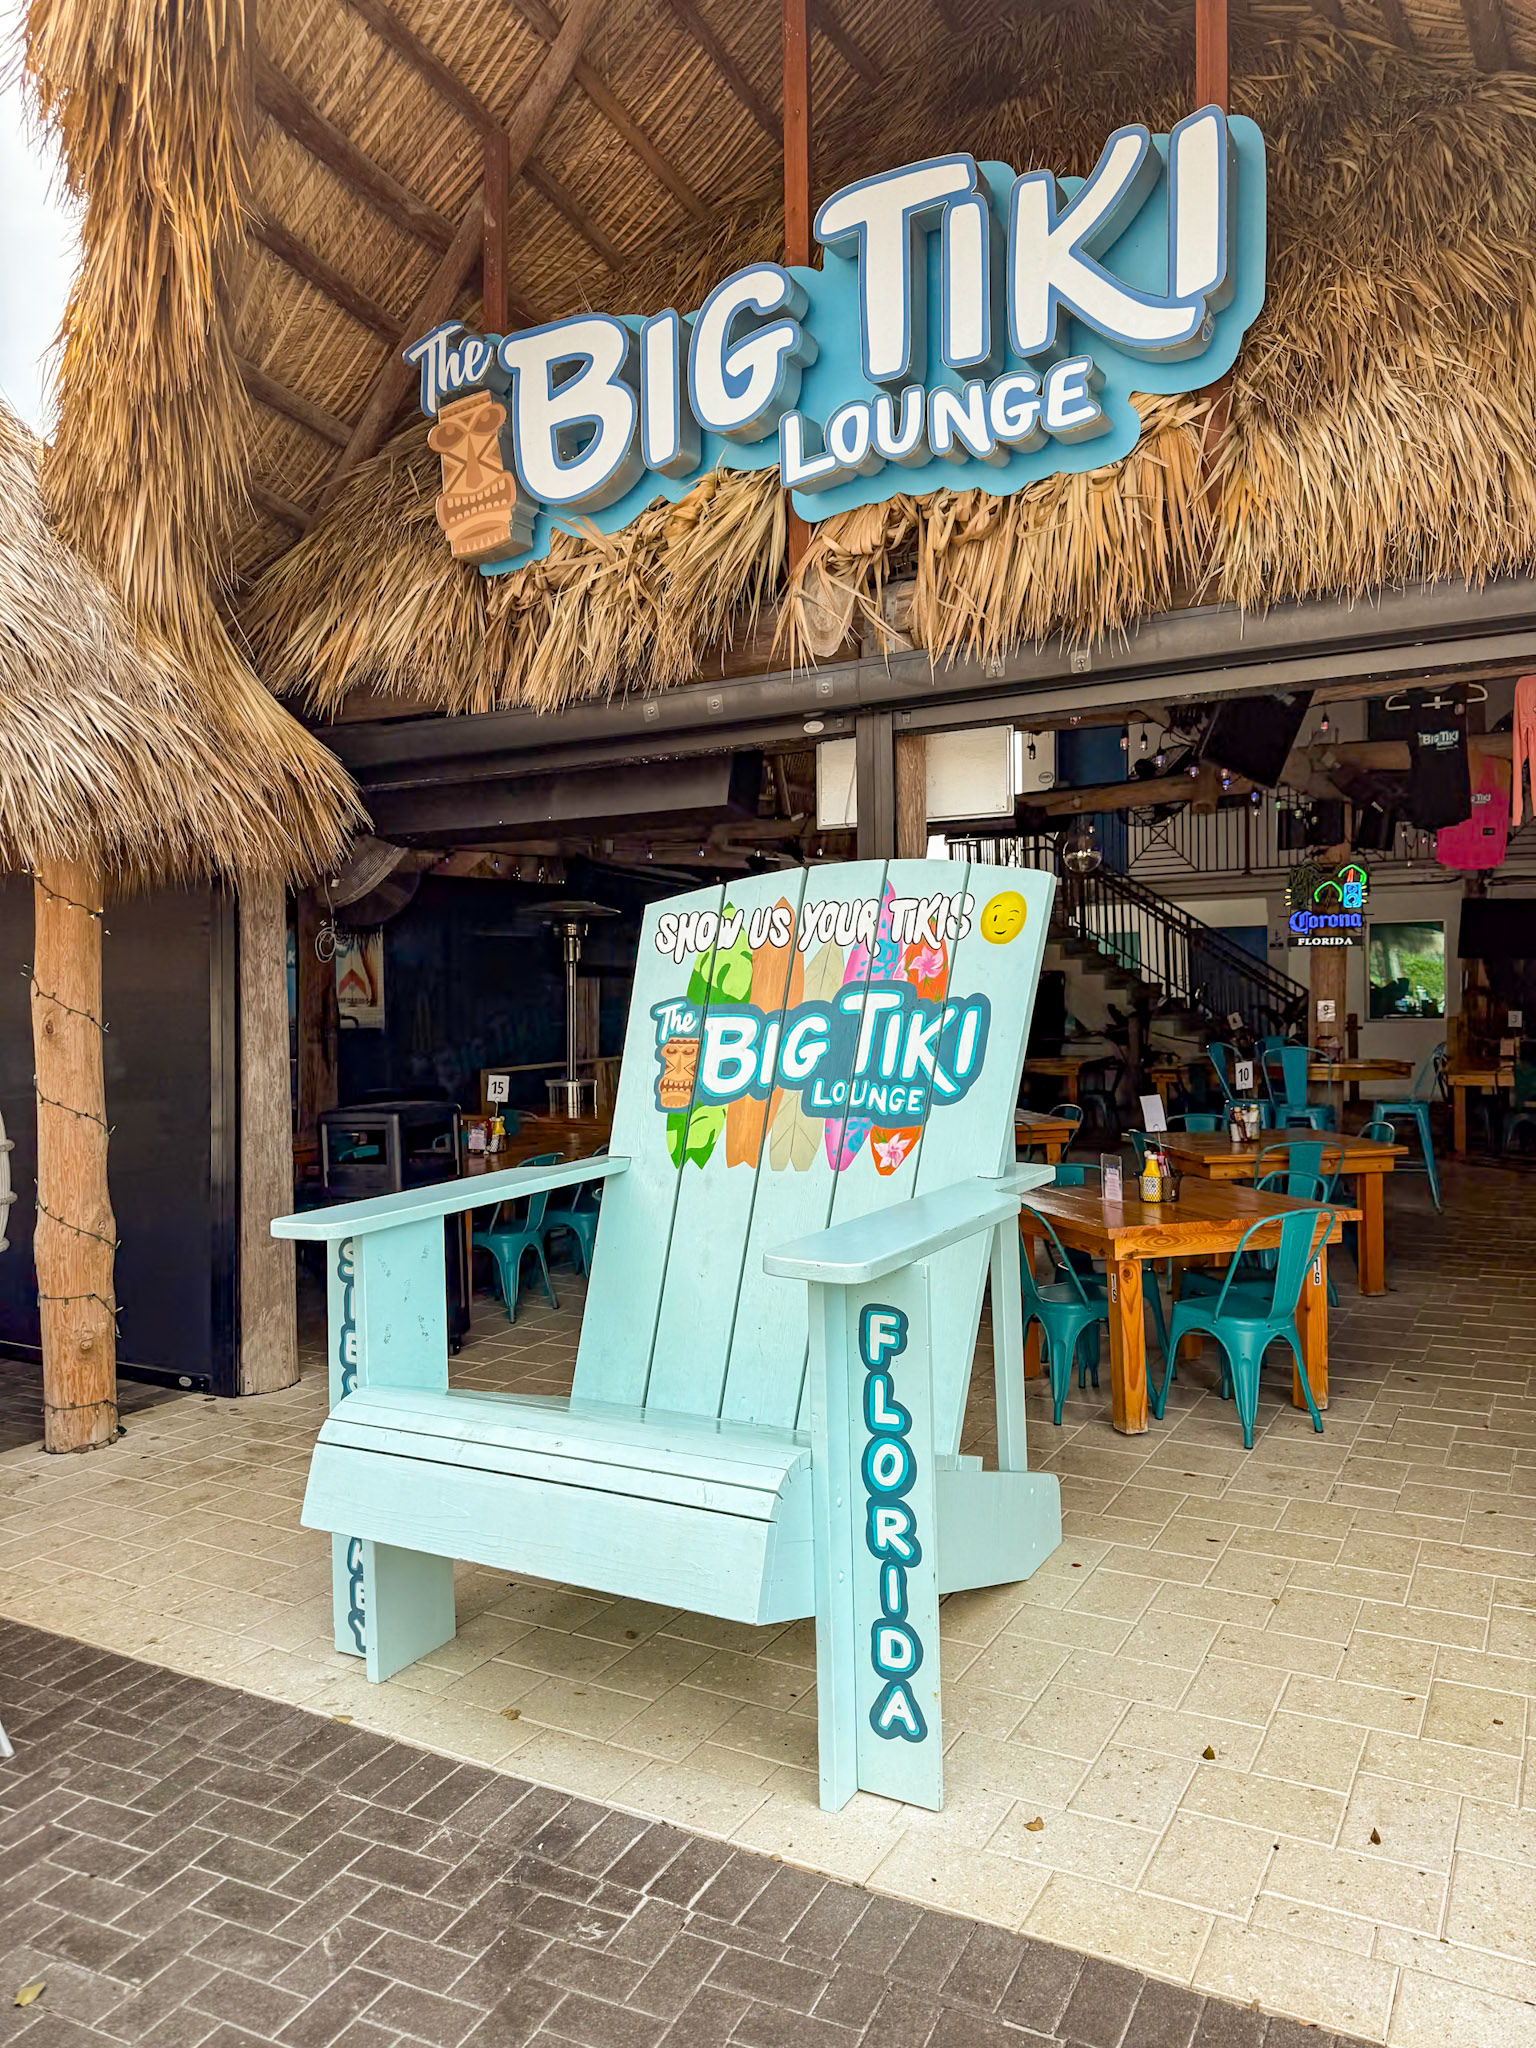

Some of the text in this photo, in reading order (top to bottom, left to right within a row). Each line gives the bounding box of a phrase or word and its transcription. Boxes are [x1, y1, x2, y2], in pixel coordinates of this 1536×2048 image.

[403, 104, 1228, 504] The BIG TIKI
[778, 356, 1101, 489] LOUNGE
[655, 891, 976, 964] SHOW US YOUR TIKIS
[1289, 910, 1362, 935] Corona
[1298, 937, 1354, 946] FLORIDA
[657, 990, 982, 1095] The BIG TIKI
[491, 1081, 504, 1095] 15
[812, 1078, 927, 1113] LOUNGE
[1238, 1067, 1249, 1081] 10
[861, 1306, 925, 1740] FLORIDA
